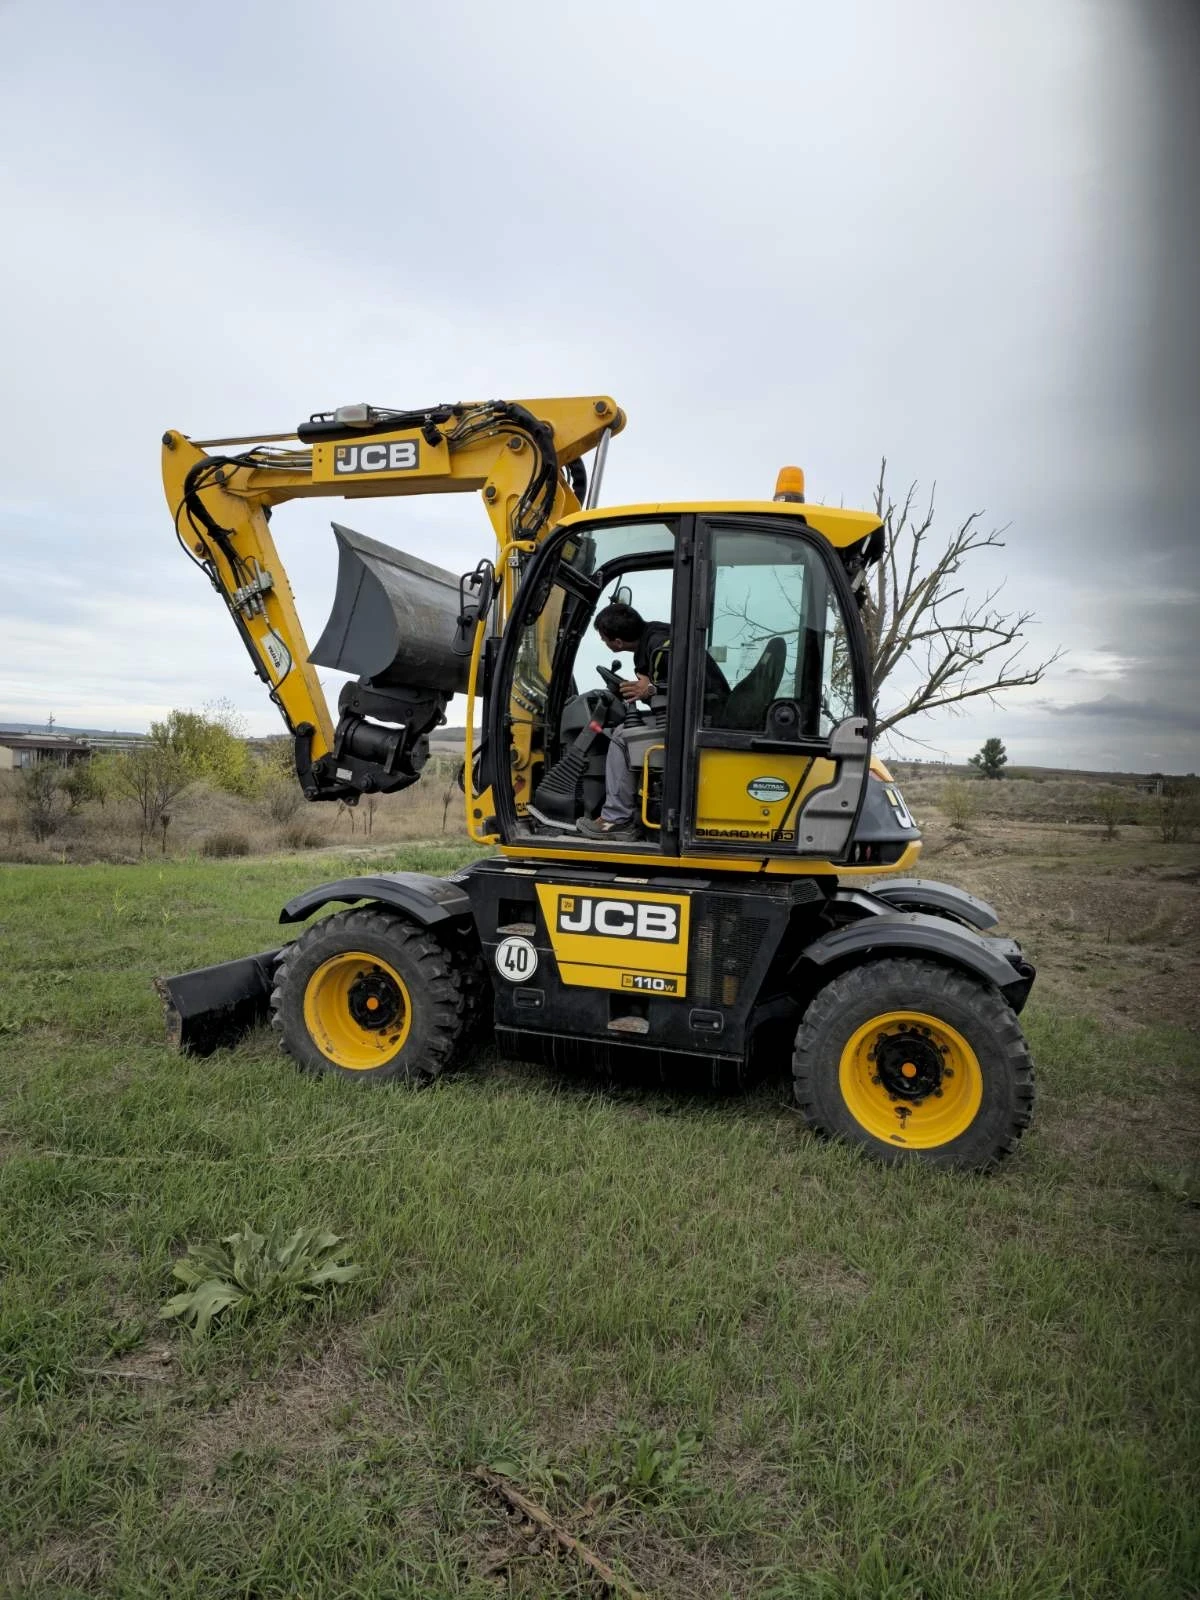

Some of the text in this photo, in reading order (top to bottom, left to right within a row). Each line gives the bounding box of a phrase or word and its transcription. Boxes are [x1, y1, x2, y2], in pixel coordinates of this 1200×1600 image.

[337, 442, 416, 472] JCB
[560, 899, 677, 940] JCB
[504, 945, 528, 972] 40
